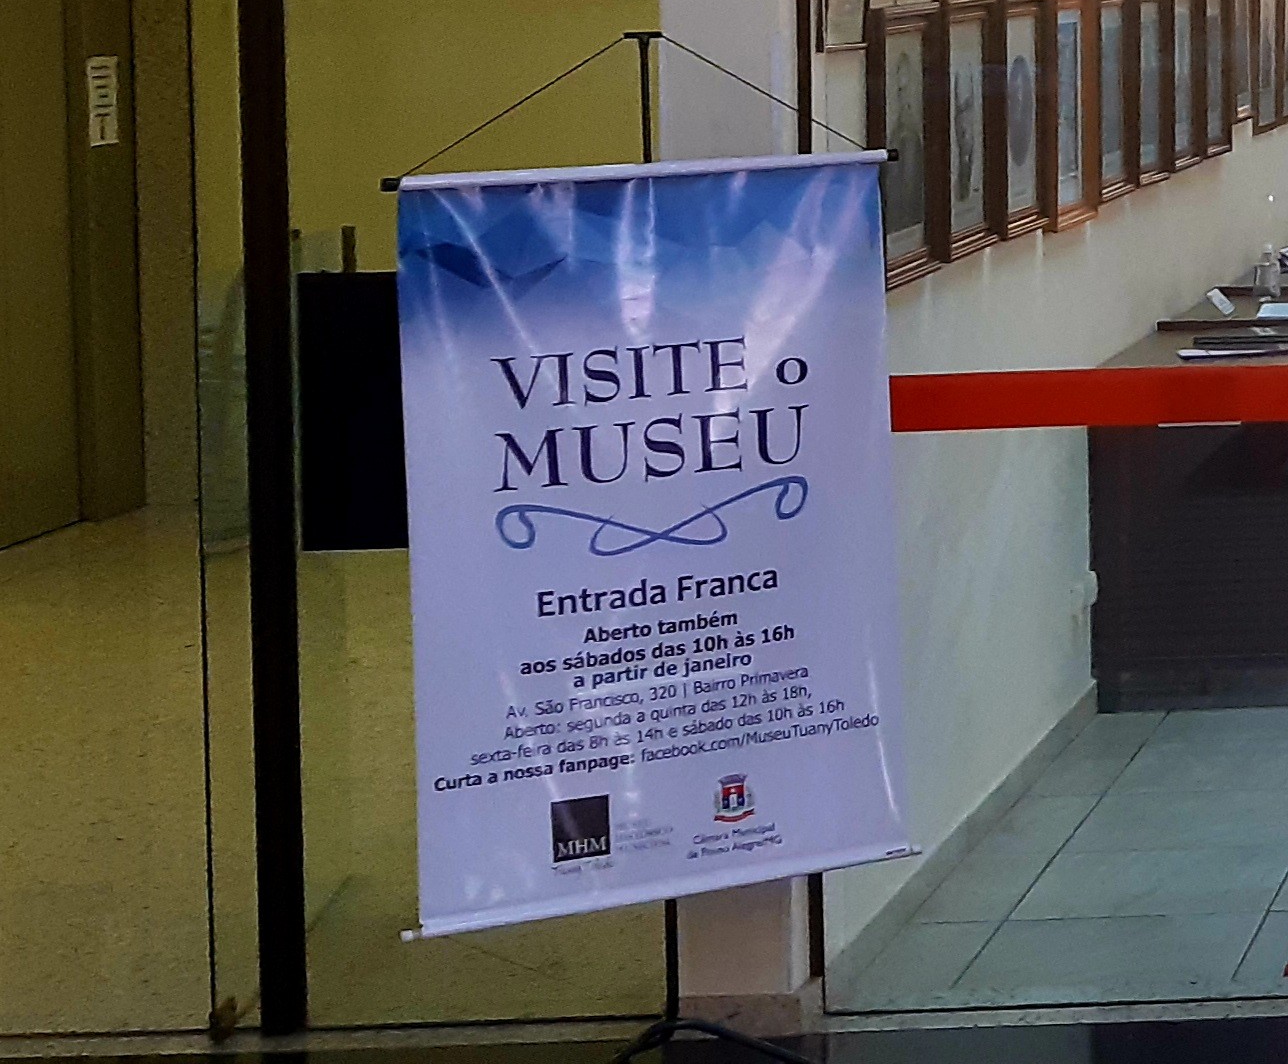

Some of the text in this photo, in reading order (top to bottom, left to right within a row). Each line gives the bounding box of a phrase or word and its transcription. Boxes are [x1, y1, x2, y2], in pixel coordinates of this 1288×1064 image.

[490, 336, 808, 410] VISITE o
[493, 404, 809, 493] MUSEU
[537, 567, 779, 618] Entrada Franca
[520, 624, 795, 675] aos sábados das 10h às 16h
[584, 611, 738, 644] Aberto também
[506, 704, 529, 720] Av.
[535, 697, 565, 716] São
[568, 691, 645, 713] Francisco,
[649, 684, 678, 702] 320
[693, 676, 736, 696] Bairro
[740, 665, 809, 689] Primavera
[573, 652, 752, 690] a partir de janeiro
[470, 742, 552, 766] sexta-feira
[557, 736, 584, 755] das
[589, 734, 609, 751] 8h
[636, 726, 665, 744] 14h
[668, 726, 679, 739] e
[682, 715, 733, 739] sábado
[738, 710, 762, 728] das
[767, 705, 794, 723] 10h
[797, 701, 814, 719] às
[818, 698, 845, 715] 16h
[503, 683, 813, 742] Aberto: segunda a quinta das 12h às 18h,
[434, 713, 880, 792] Curta a nossa fanpage: facebook.com/MuseuTuanyToledo
[557, 836, 607, 858] MHM
